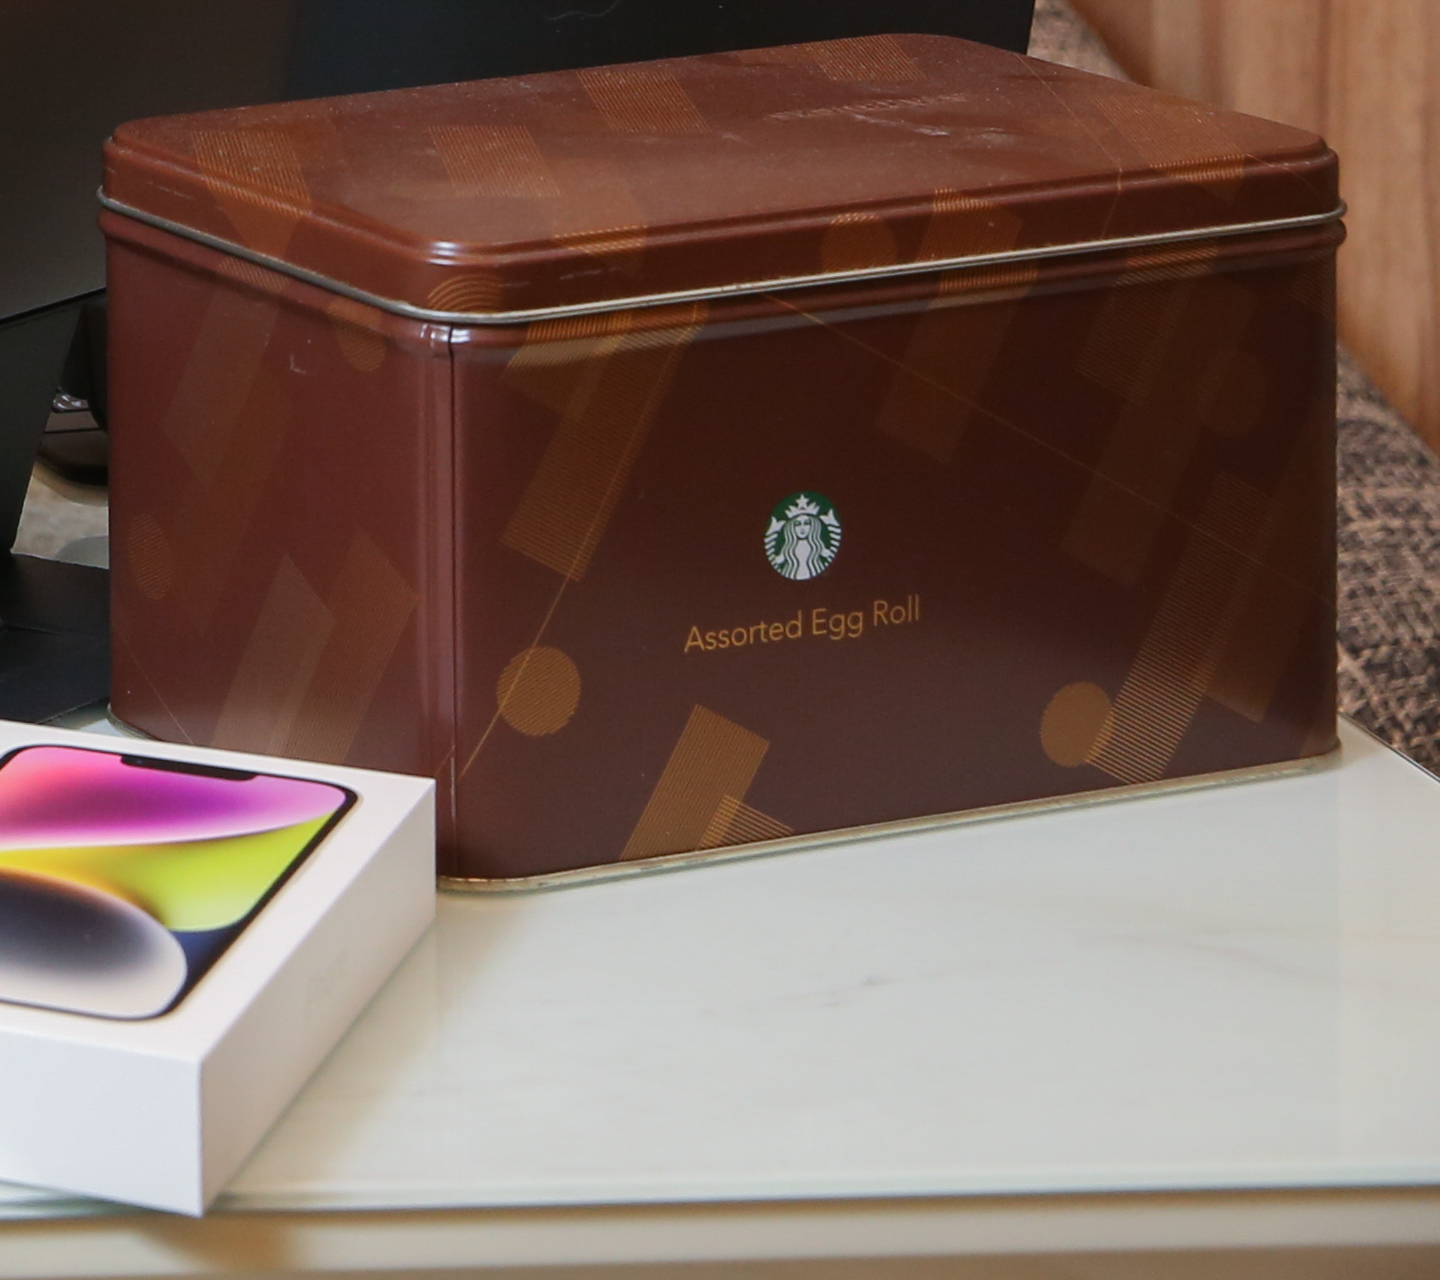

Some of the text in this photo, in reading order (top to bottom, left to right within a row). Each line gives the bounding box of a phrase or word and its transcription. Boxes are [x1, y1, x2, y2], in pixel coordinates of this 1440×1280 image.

[684, 593, 920, 653] Assorted Egg Roll
